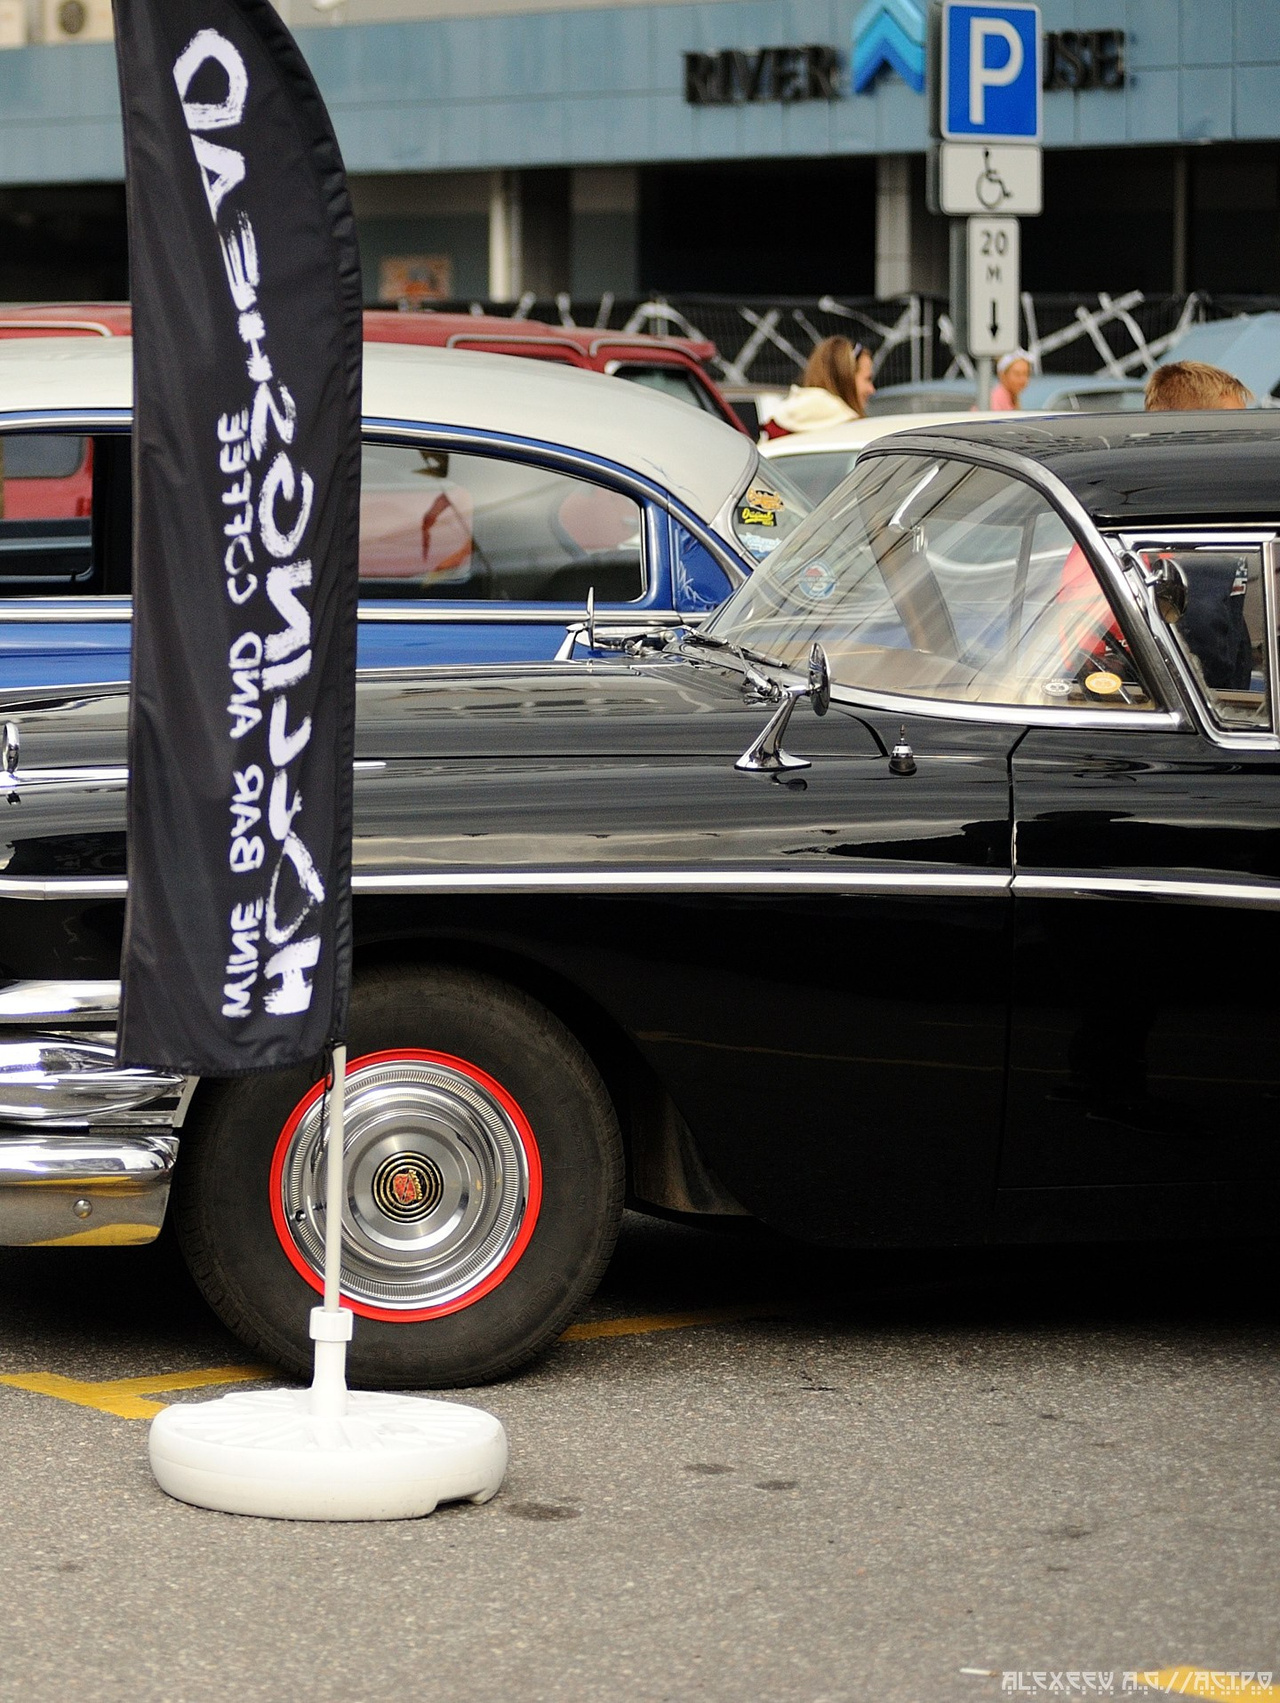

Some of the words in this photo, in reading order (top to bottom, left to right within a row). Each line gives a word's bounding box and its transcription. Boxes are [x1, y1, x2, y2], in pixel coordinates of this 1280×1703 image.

[685, 46, 838, 104] RIVER
[1043, 30, 1125, 92] USE
[969, 16, 1024, 126] P
[980, 230, 1009, 256] 20
